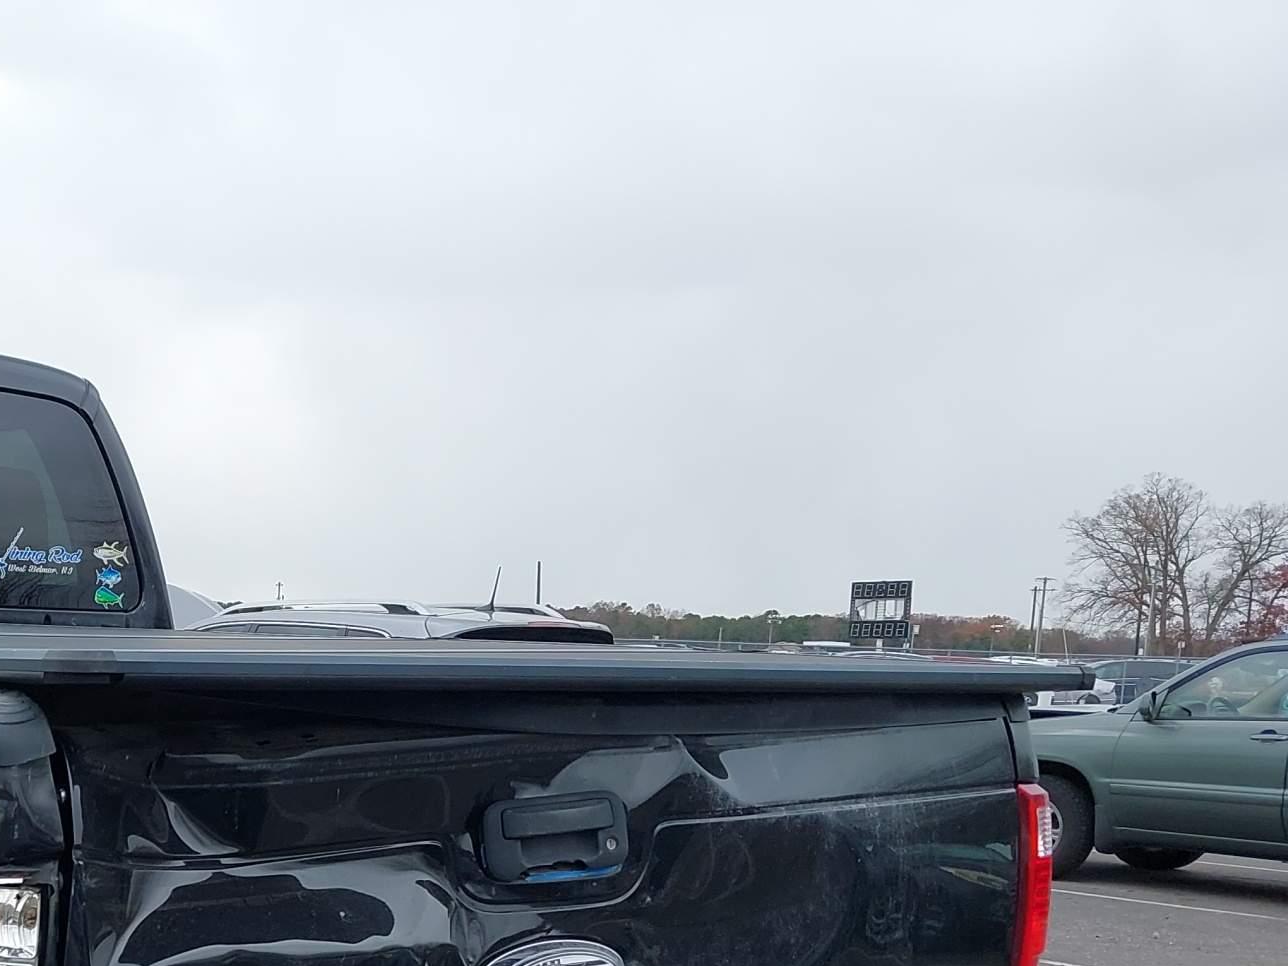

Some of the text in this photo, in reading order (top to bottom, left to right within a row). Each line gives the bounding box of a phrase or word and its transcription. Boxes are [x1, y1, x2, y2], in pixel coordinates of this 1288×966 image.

[48, 546, 82, 563] Rod
[8, 564, 26, 573] West
[61, 566, 73, 575] NJ
